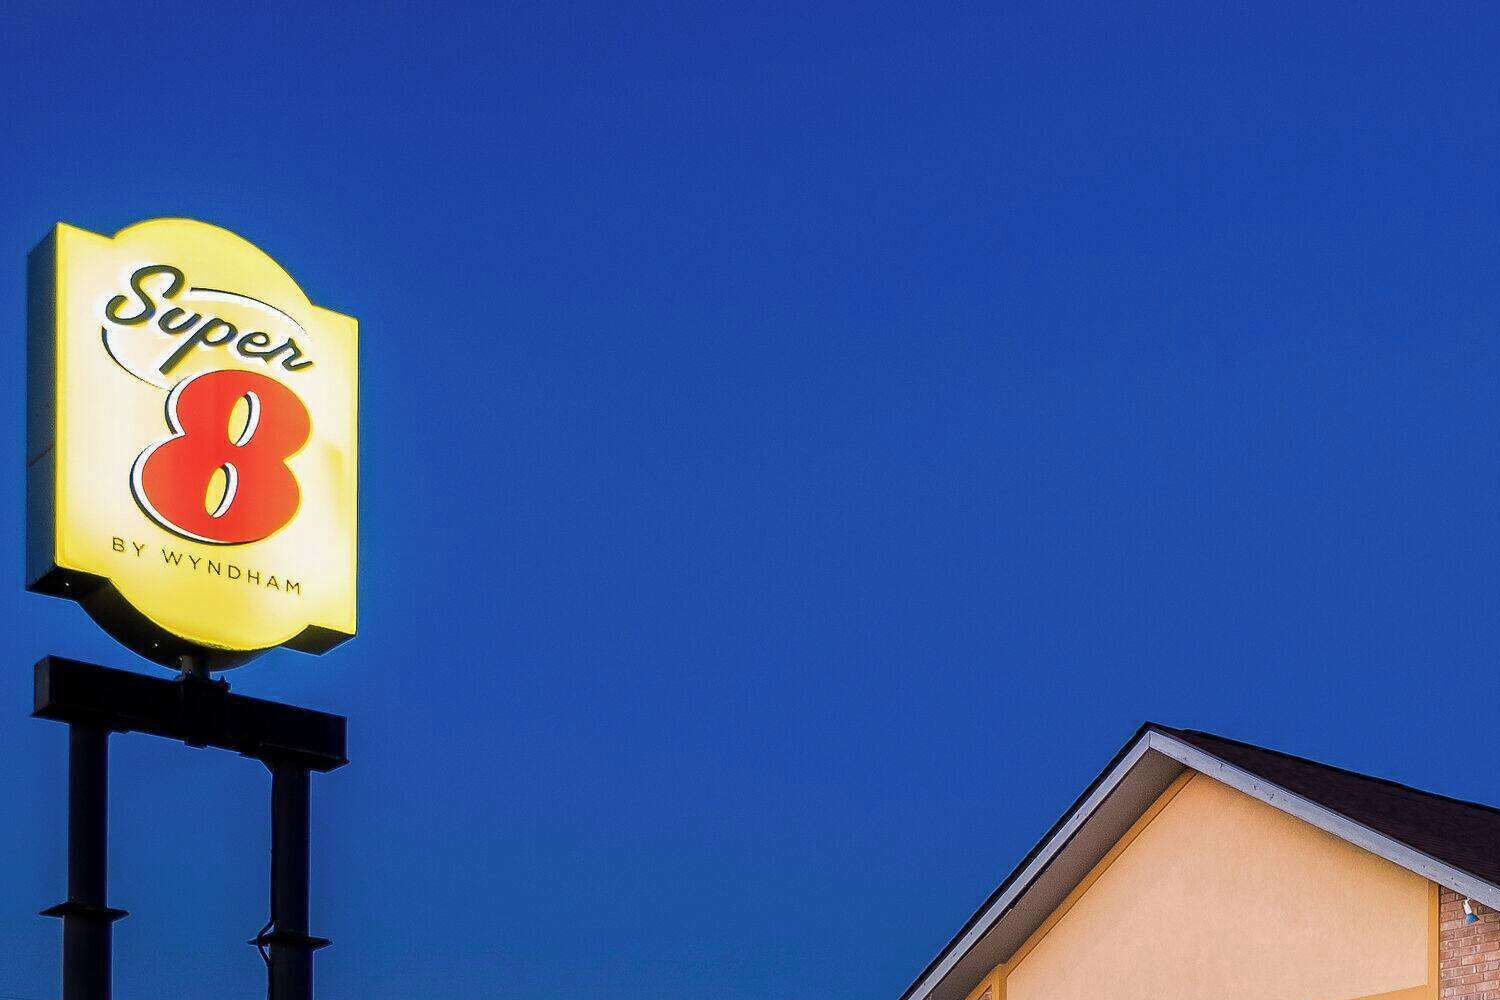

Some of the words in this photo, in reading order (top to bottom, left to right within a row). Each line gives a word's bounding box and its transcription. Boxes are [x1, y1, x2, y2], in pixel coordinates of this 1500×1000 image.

[105, 264, 313, 376] Super
[131, 369, 312, 545] 8
[112, 536, 145, 557] BY
[161, 548, 302, 595] WYNDHAM
